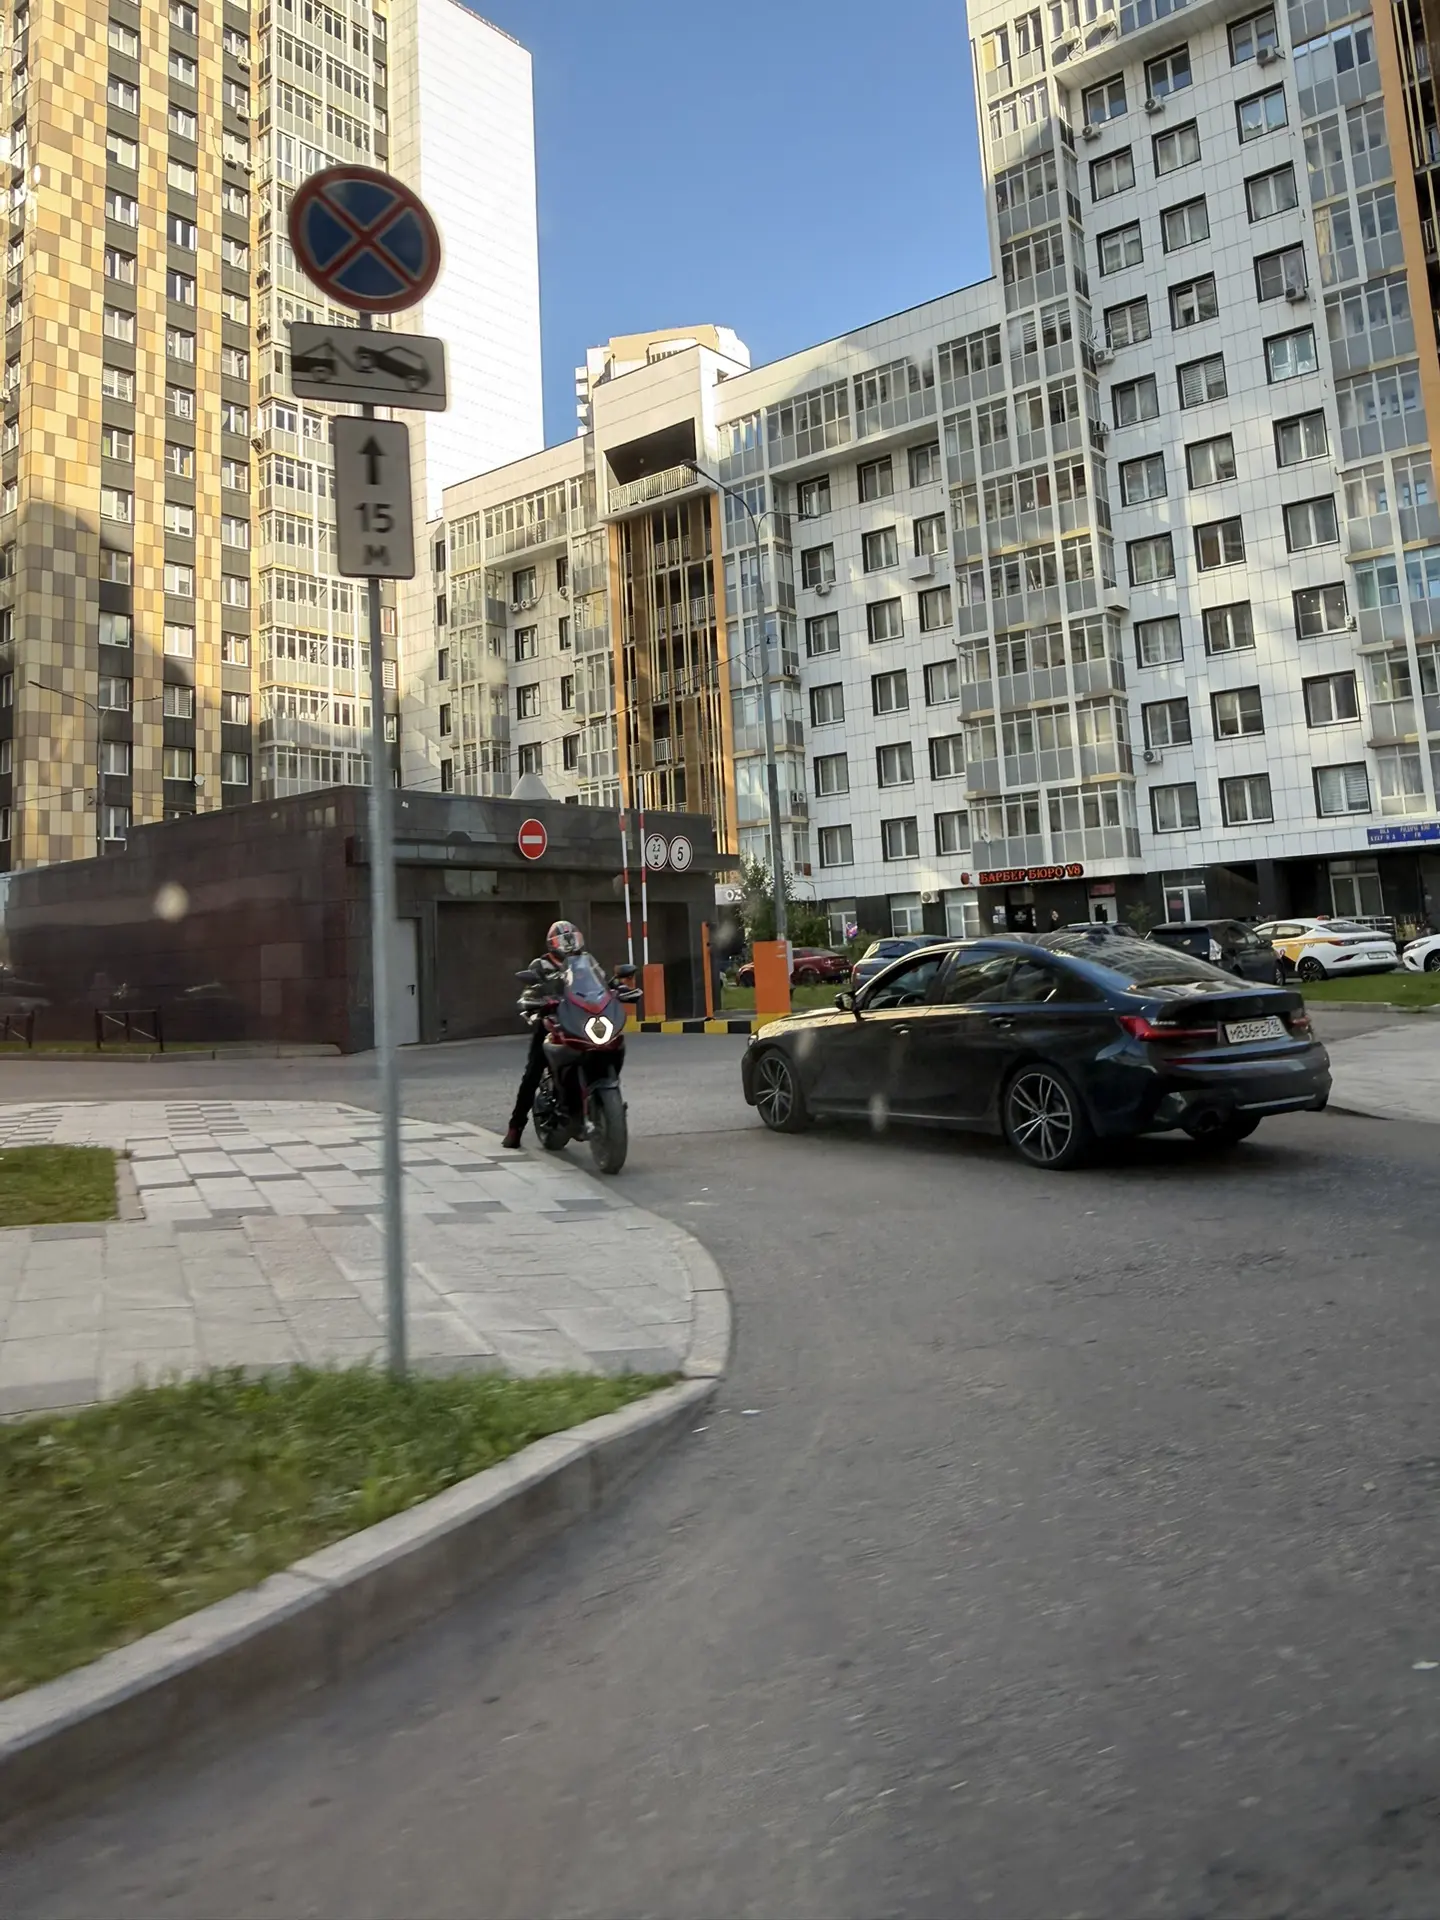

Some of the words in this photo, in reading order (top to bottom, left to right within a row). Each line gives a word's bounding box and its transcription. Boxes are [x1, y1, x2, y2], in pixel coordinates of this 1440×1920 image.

[354, 502, 395, 533] 15
[677, 847, 683, 861] 5
[980, 870, 1026, 884] БАРБЕР
[1028, 866, 1064, 880] БЮРО
[1066, 864, 1082, 876] V8
